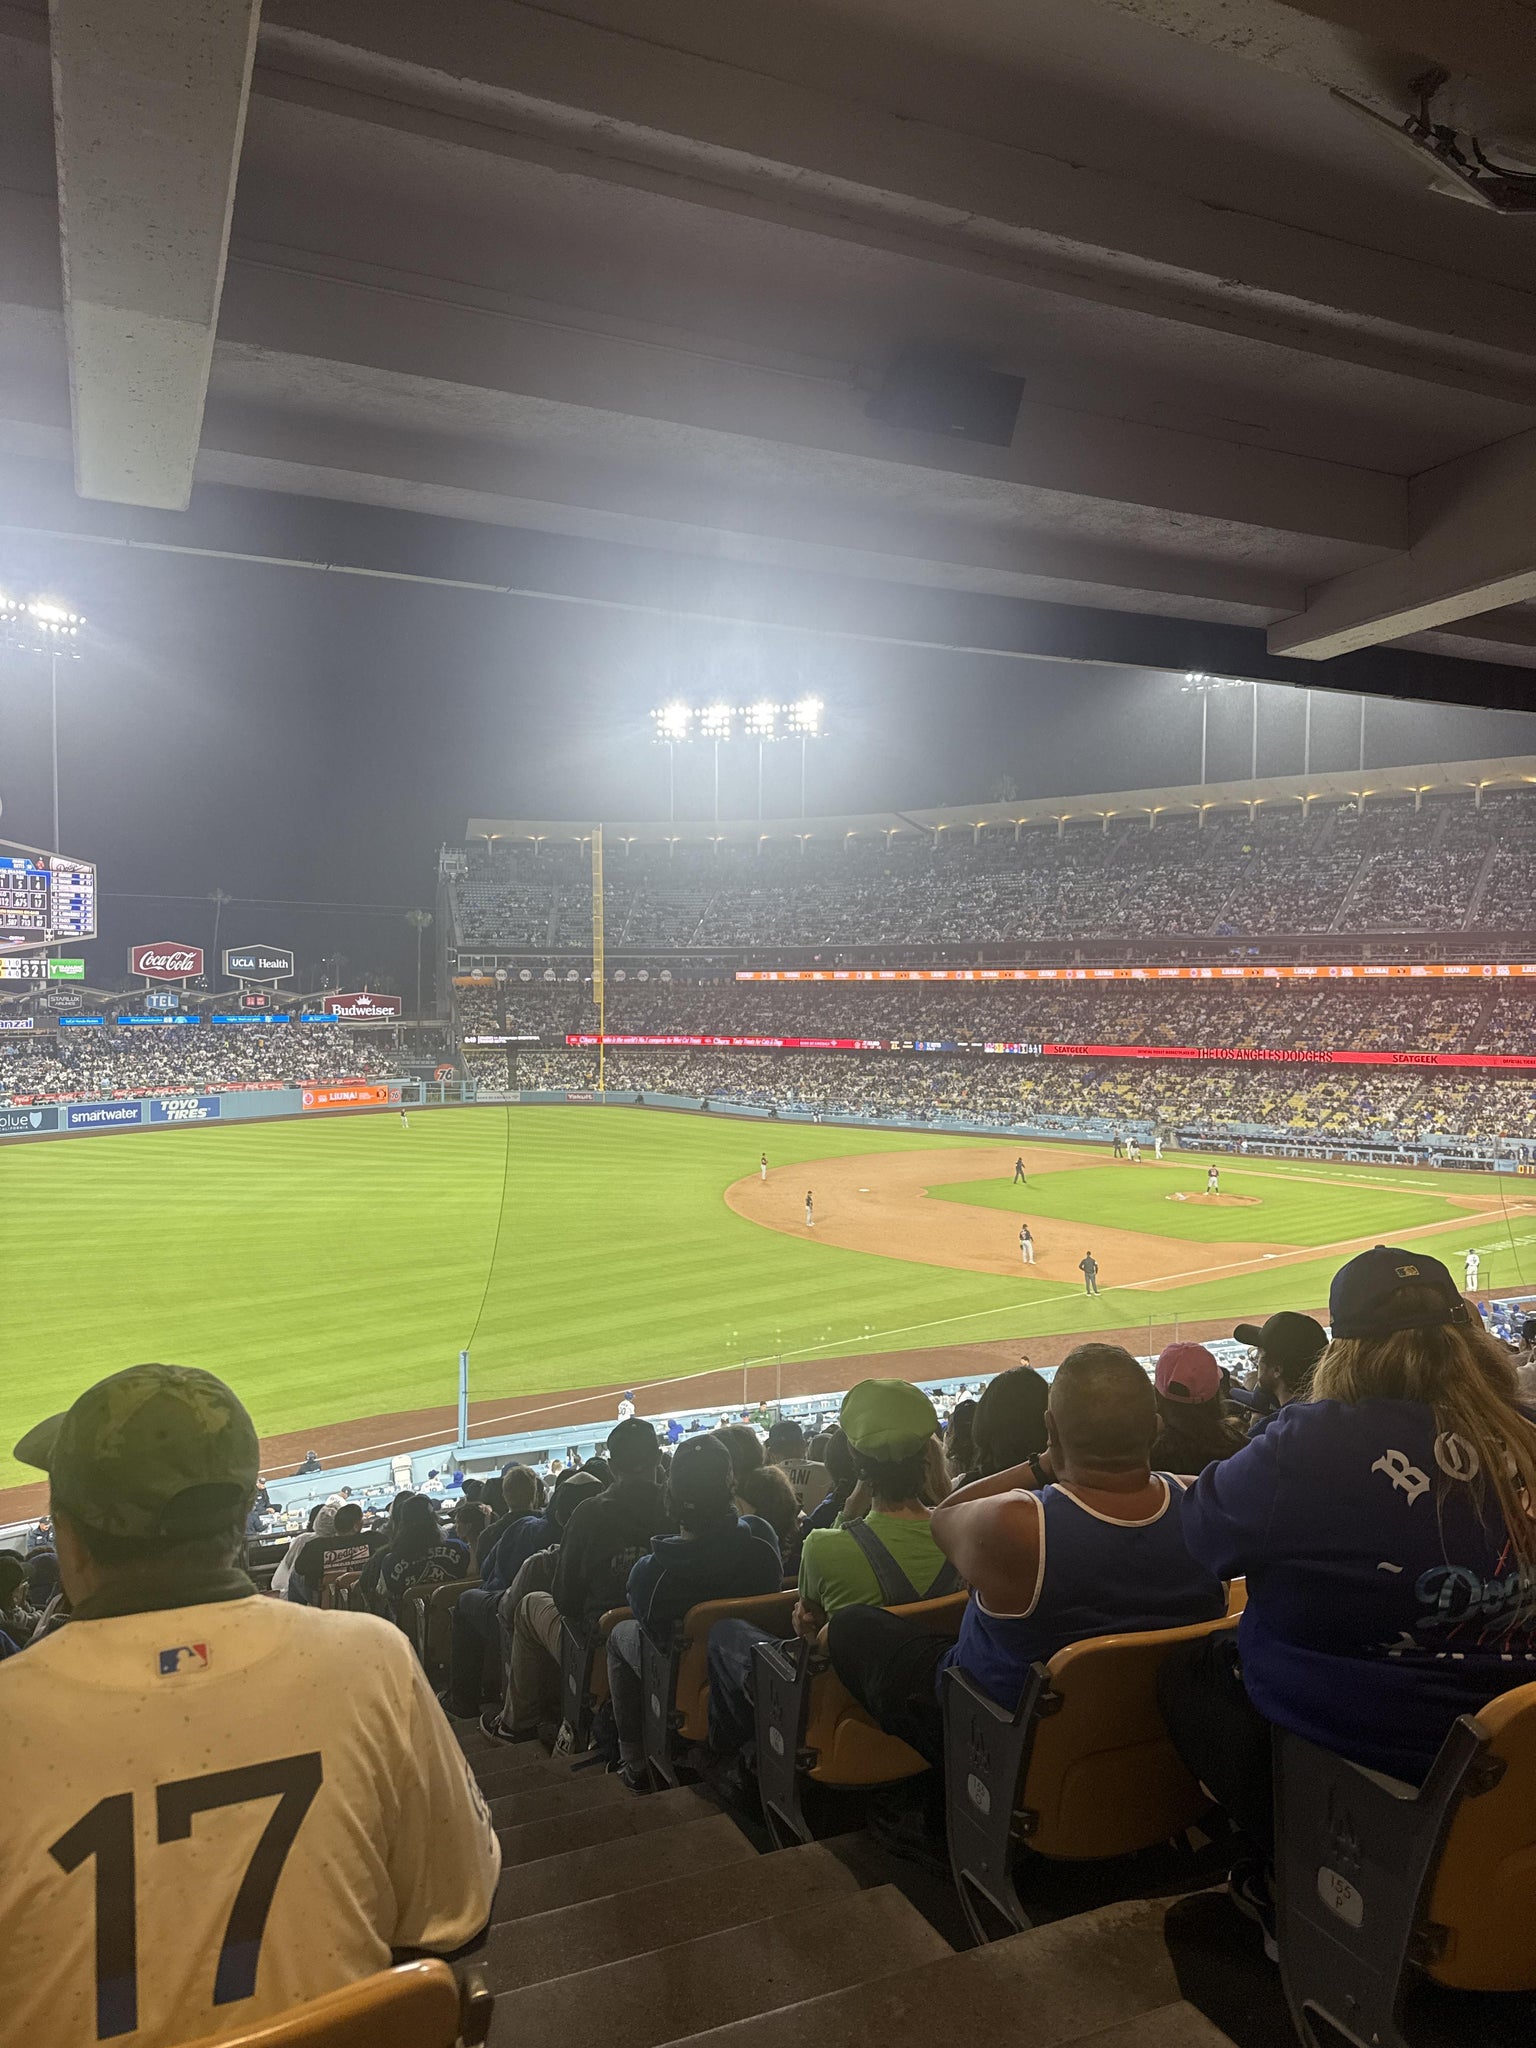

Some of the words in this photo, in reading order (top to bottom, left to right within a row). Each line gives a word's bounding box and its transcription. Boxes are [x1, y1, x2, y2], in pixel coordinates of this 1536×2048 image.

[139, 951, 197, 971] Coca-Cola
[231, 958, 255, 968] UCLA
[258, 958, 289, 969] Health
[22, 964, 30, 978] 3
[31, 964, 39, 978] 2
[332, 1003, 395, 1016] Budweiser
[1053, 1045, 1089, 1054] SEATGEEK
[1216, 1048, 1235, 1059] LOS
[1237, 1049, 1281, 1060] ANGELES
[1282, 1050, 1333, 1062] DODGERS
[1392, 1054, 1438, 1064] SEATGEEK
[437, 1068, 454, 1081] 76
[329, 1091, 358, 1101] LIUNA!
[160, 1099, 199, 1111] TOYO
[71, 1107, 139, 1124] smartwater
[166, 1108, 208, 1120] TIRES
[790, 1468, 811, 1485] ANI
[391, 1559, 409, 1581] LOS
[1329, 1874, 1352, 1900] 155
[48, 1751, 324, 2042] 17
